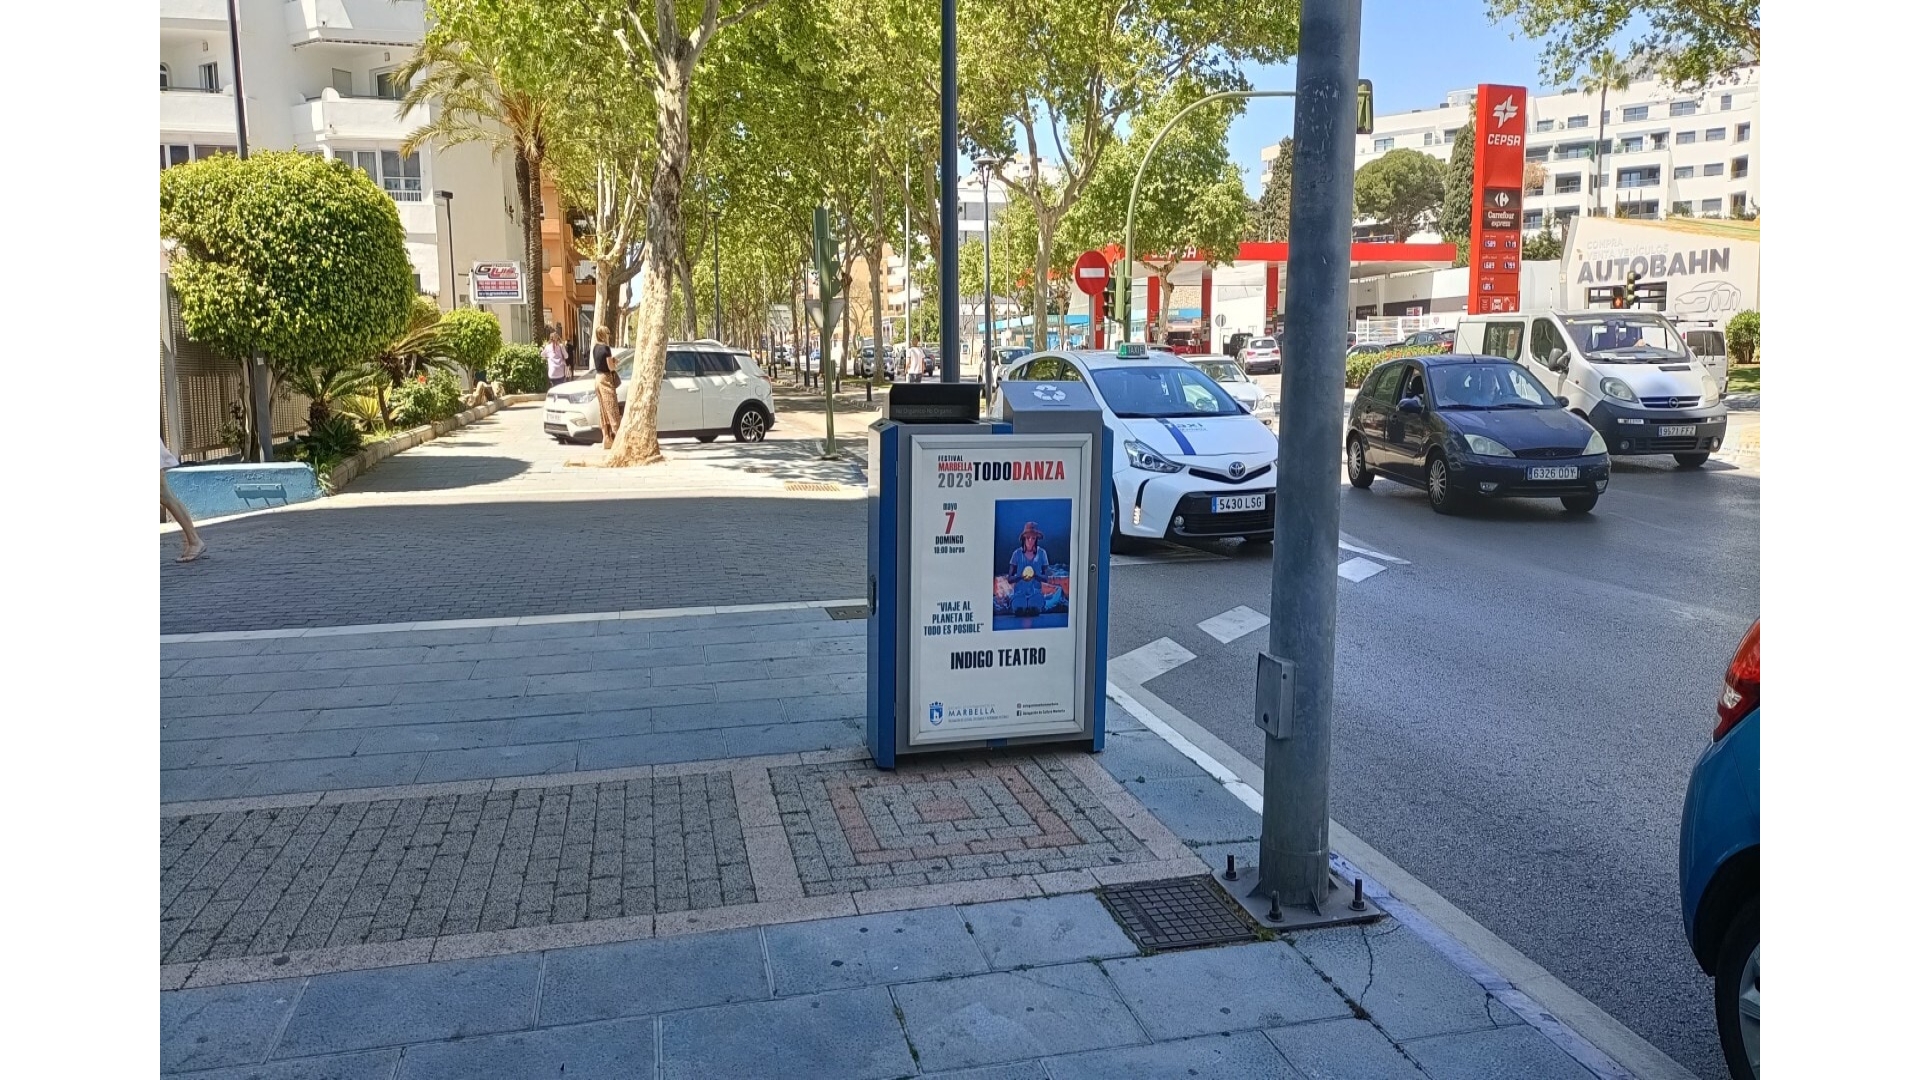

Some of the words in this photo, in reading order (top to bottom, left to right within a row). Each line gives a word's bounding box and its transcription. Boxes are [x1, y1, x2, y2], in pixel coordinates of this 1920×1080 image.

[1487, 133, 1521, 147] CEPSA
[1487, 210, 1515, 220] Carrefour
[1490, 220, 1511, 228] express
[1586, 237, 1623, 251] COMPRA
[1586, 249, 1615, 261] VENTA
[1577, 247, 1731, 285] AUTOBAHN
[1127, 345, 1140, 354] TAXI
[938, 462, 973, 472] MARBELLA
[1533, 468, 1556, 479] 6326
[938, 472, 973, 488] 2023
[943, 502, 958, 511] mayo
[1219, 498, 1243, 510] 5430
[1245, 496, 1262, 509] LSG
[945, 511, 955, 535] 7
[935, 535, 964, 545] DOMINGO
[949, 545, 965, 554] horas
[962, 600, 971, 611] AL
[932, 612, 963, 624] PLANETA
[965, 612, 974, 622] DE
[924, 625, 941, 636] TODO
[943, 625, 952, 635] ES
[950, 649, 993, 670] INDIGO
[998, 647, 1047, 667] TEATRO
[948, 707, 996, 718] MARBELLA
